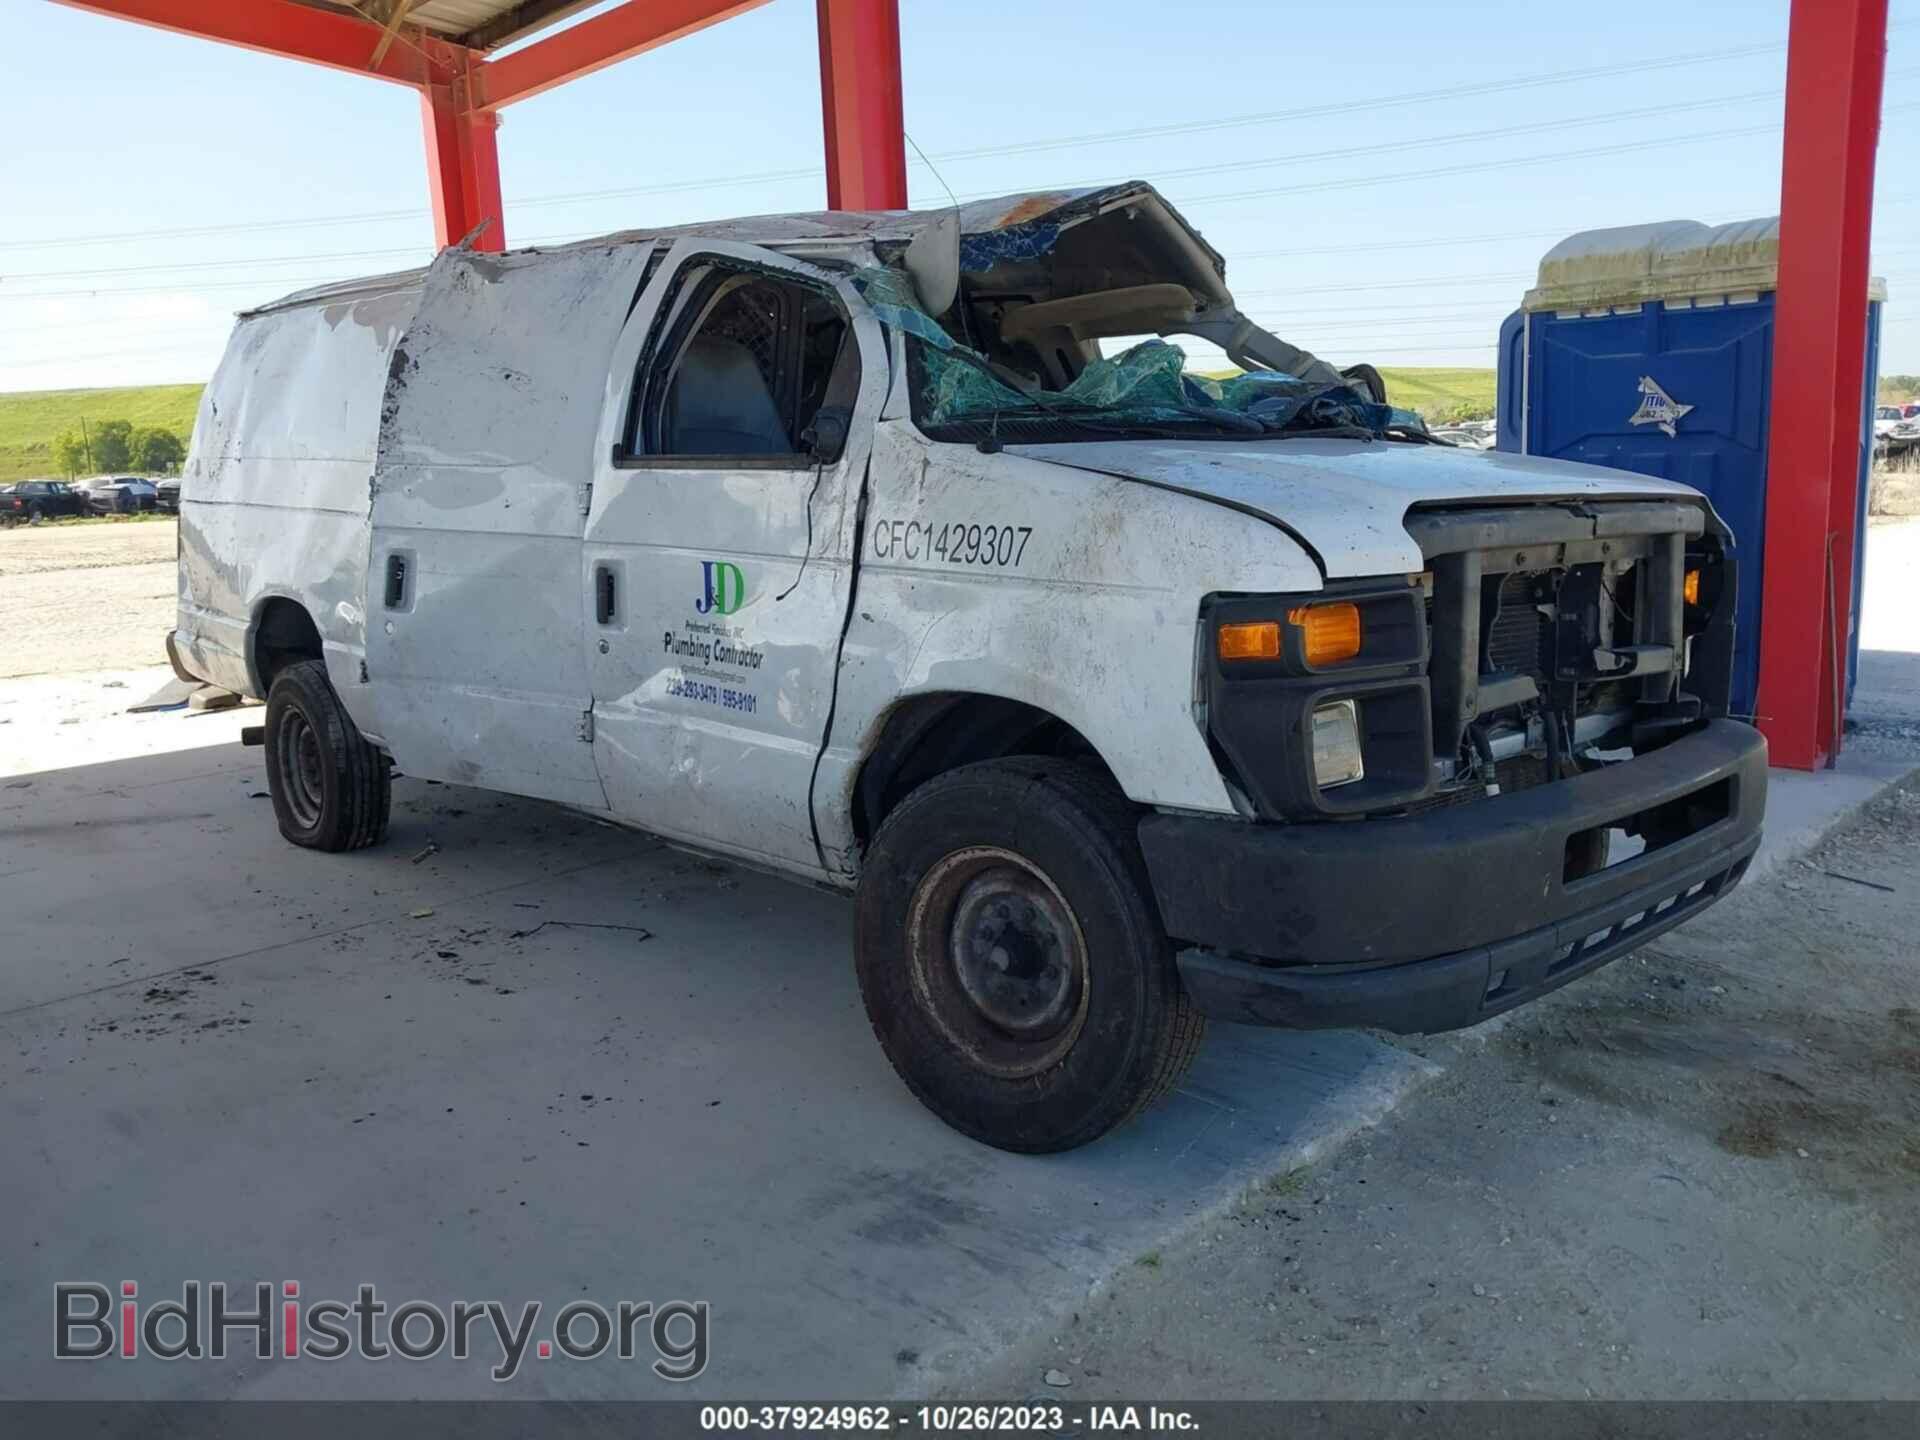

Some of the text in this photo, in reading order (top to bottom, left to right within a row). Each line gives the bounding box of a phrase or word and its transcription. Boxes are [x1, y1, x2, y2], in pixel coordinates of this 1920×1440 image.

[873, 519, 1033, 567] CFC1429307
[663, 631, 764, 670] Plumbing Contractor
[723, 688, 757, 714] 595-9101
